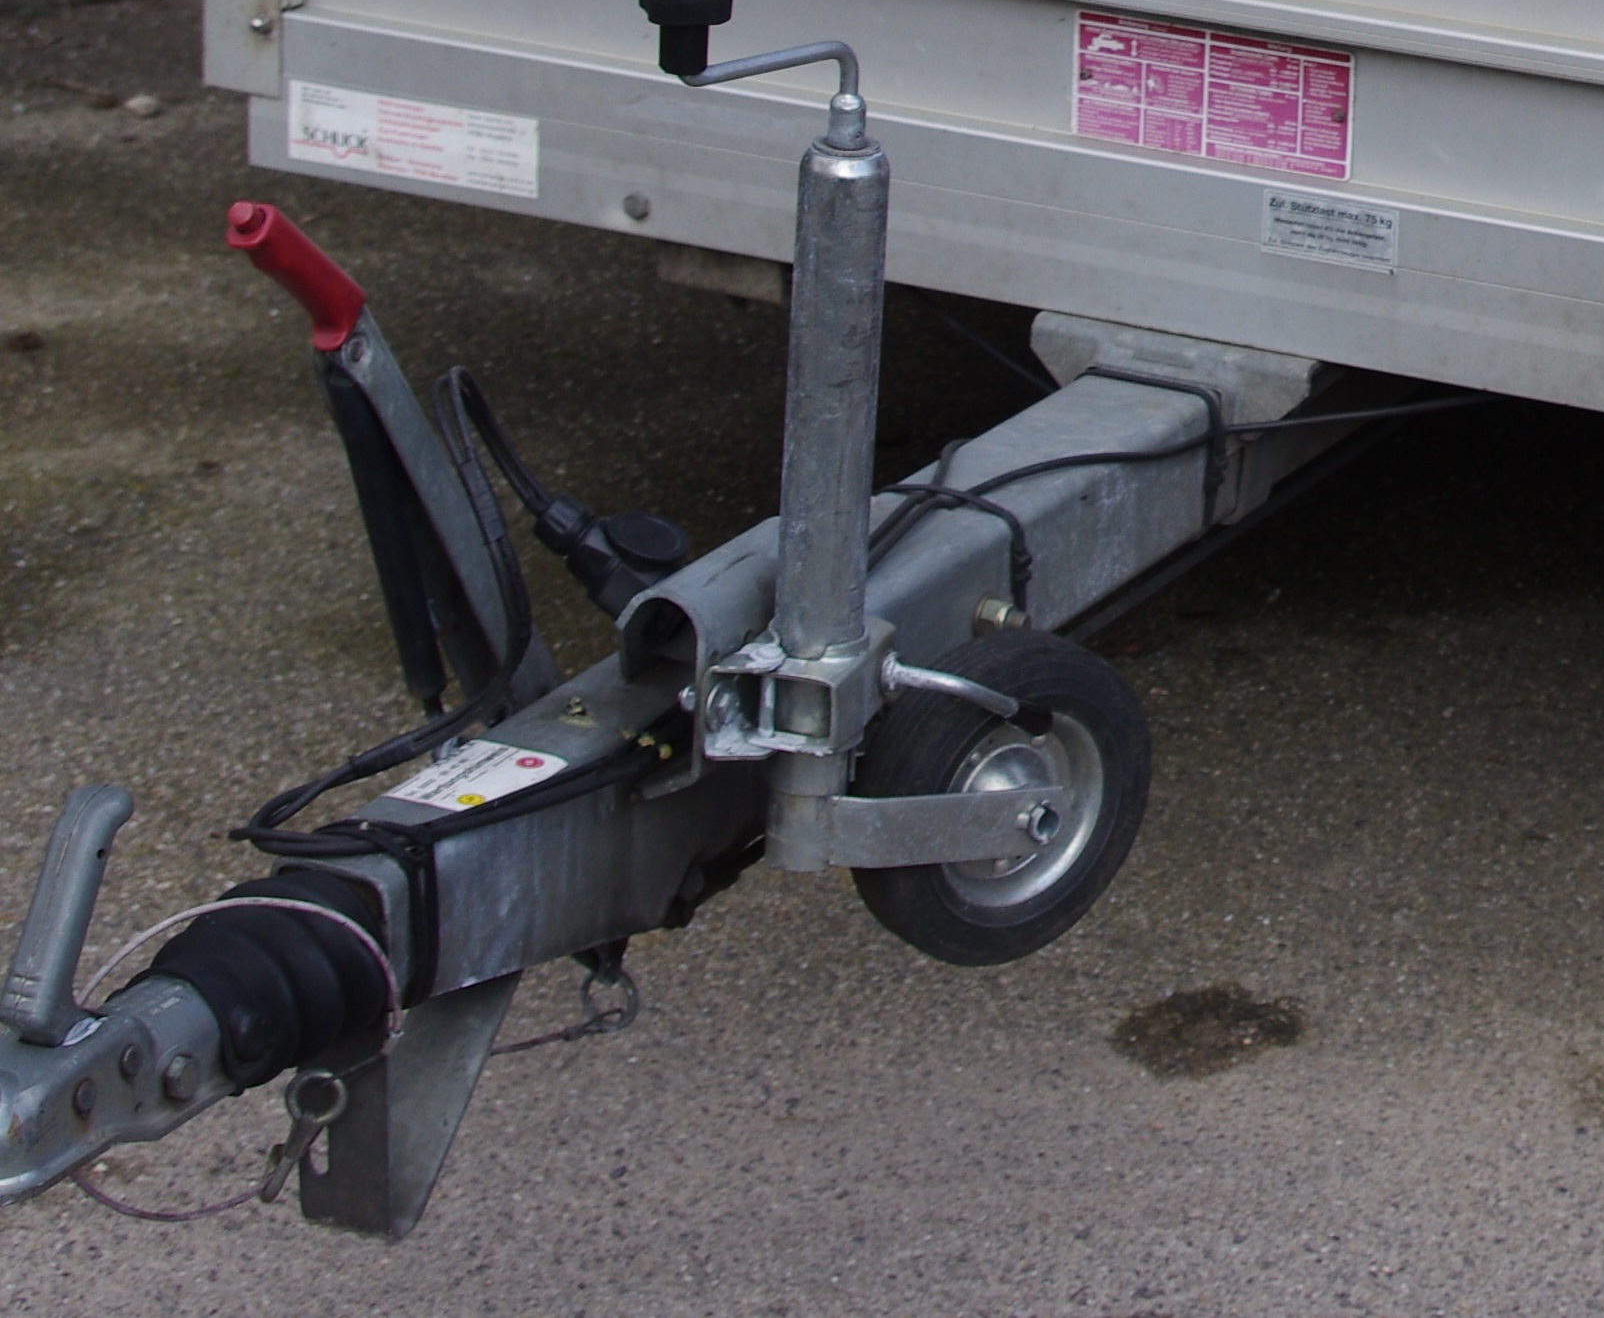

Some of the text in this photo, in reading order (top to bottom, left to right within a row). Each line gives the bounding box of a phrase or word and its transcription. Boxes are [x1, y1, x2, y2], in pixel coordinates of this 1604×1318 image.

[1290, 201, 1335, 218] Stützlast
[1365, 214, 1378, 225] 75
[1379, 216, 1393, 229] kg
